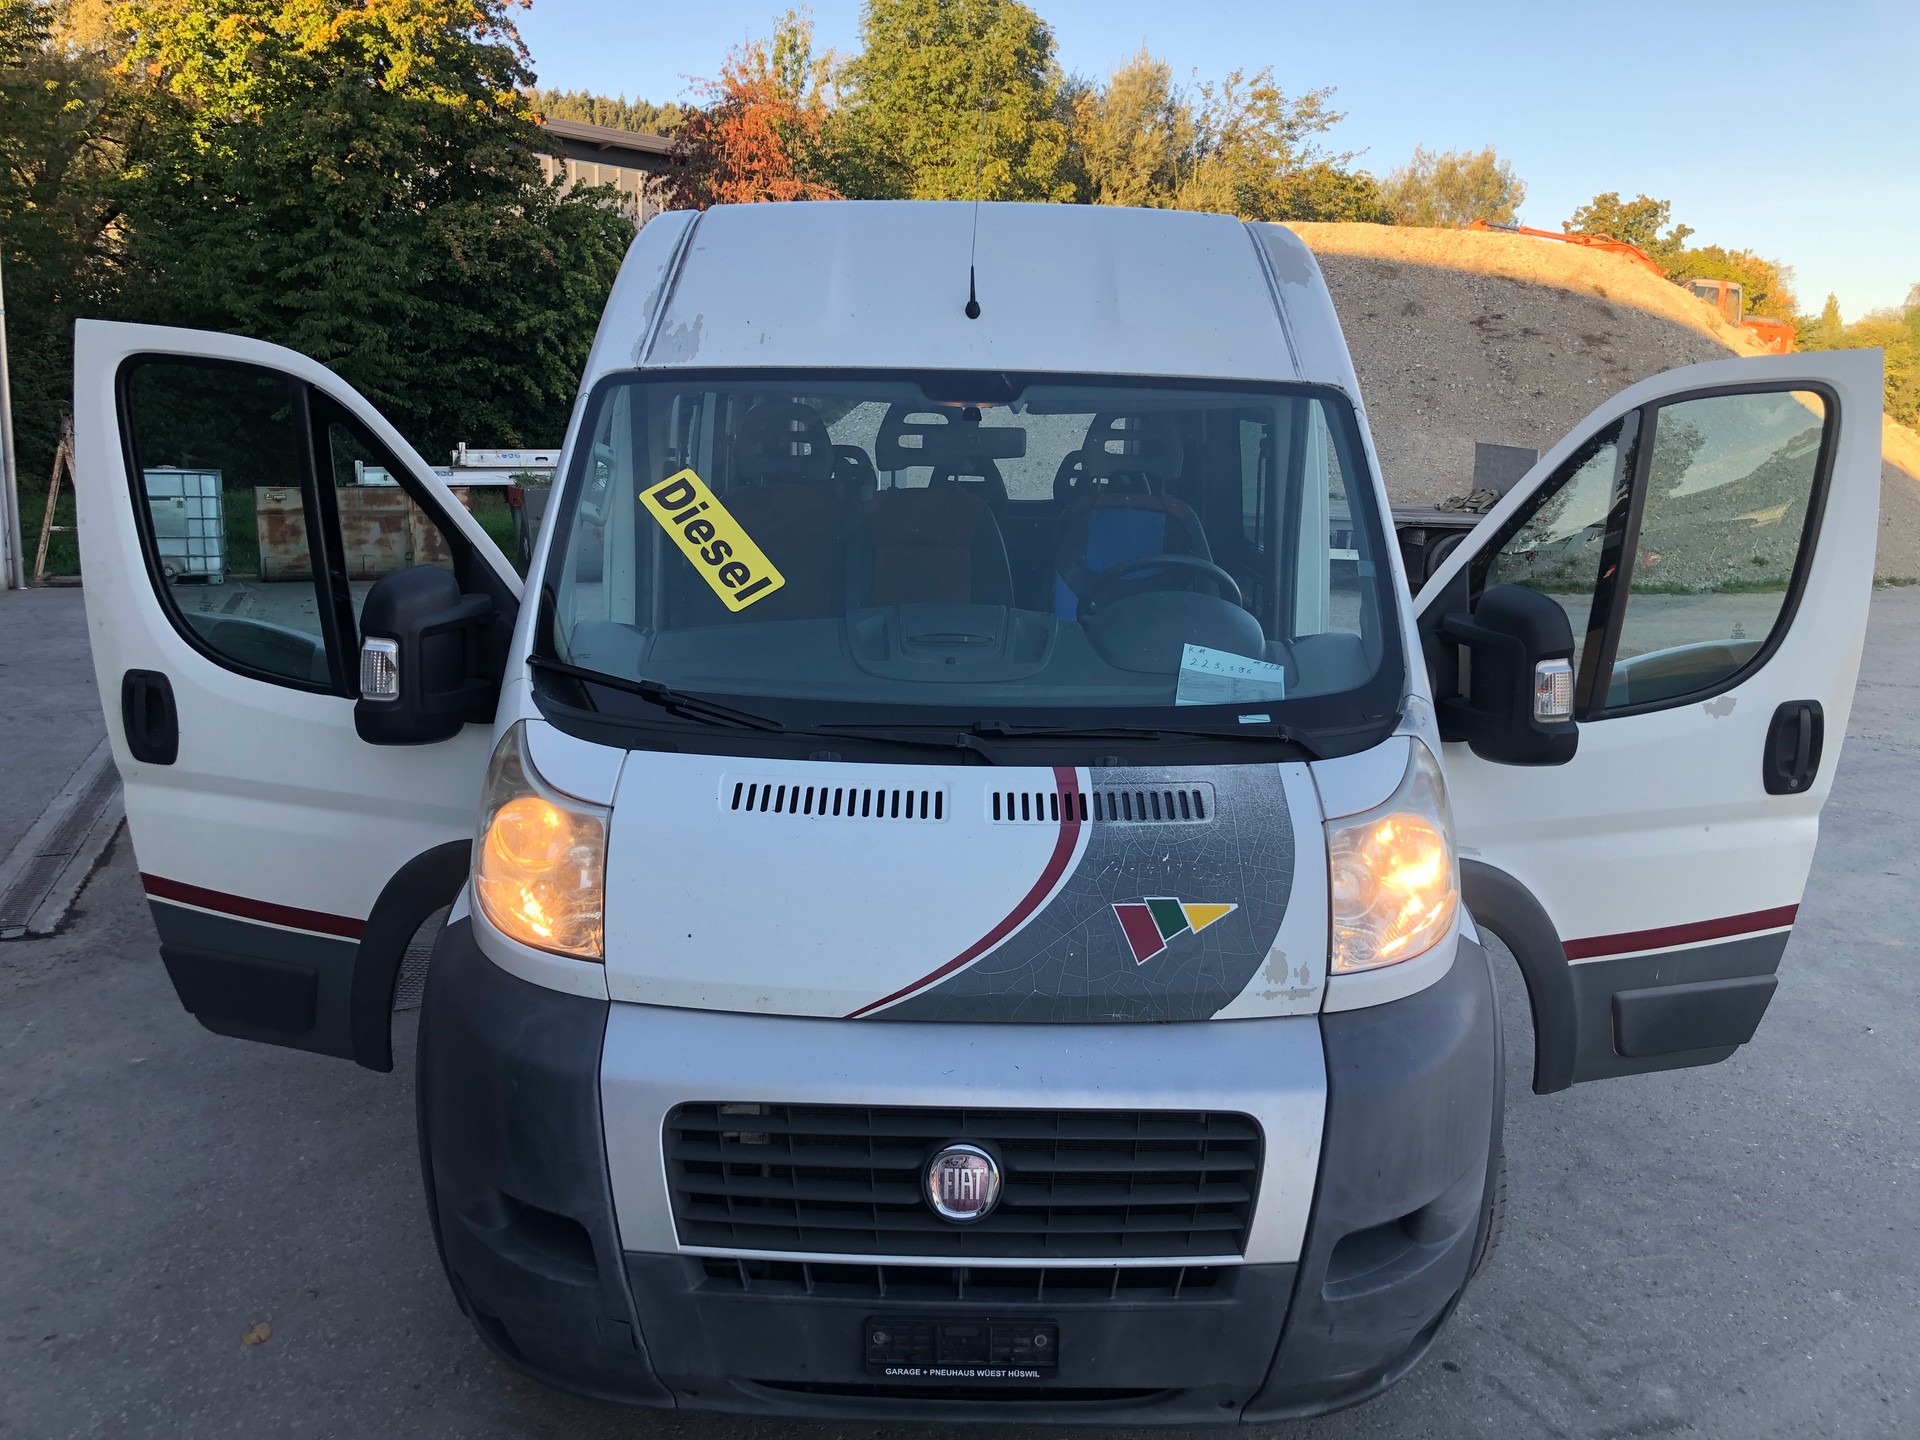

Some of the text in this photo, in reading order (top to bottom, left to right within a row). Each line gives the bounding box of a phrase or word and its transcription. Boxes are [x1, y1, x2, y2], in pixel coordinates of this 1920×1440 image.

[652, 478, 772, 602] Diesel
[943, 1168, 983, 1200] FIAT
[885, 1368, 921, 1376] GARAGE
[929, 1369, 975, 1377] PNEUHAUS
[976, 1369, 1007, 1377] WÜEST
[1008, 1369, 1041, 1378] HÜSWIL
